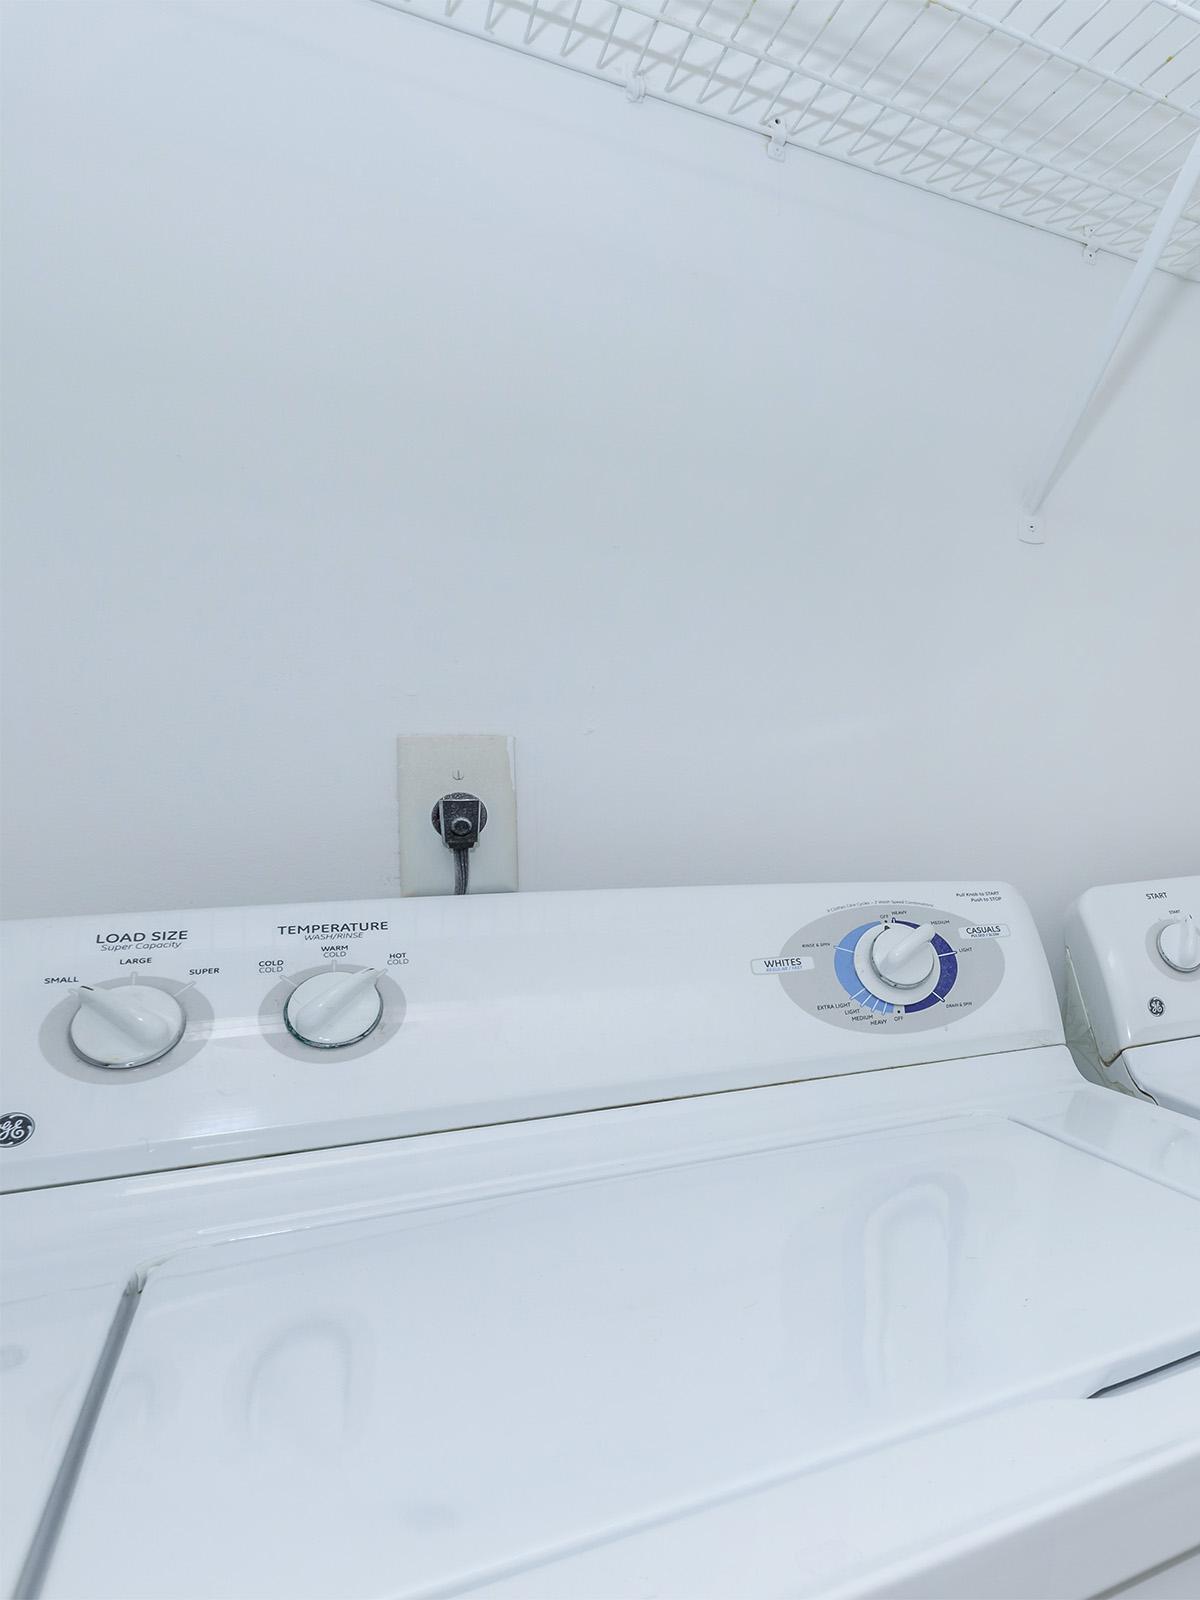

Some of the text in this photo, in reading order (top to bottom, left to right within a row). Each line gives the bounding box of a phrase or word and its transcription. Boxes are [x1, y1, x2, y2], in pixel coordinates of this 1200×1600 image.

[1146, 892, 1168, 900] START
[277, 921, 389, 935] TEMPERATURE
[966, 926, 1001, 934] CASUALS
[96, 930, 188, 944] LOAD SIZE
[304, 932, 364, 941] WASH/RINSE
[100, 941, 182, 952] Super Capacity
[119, 957, 152, 965] LARGE
[764, 958, 802, 968] WHITES
[189, 967, 220, 975] SUPER
[259, 966, 283, 974] COLD
[44, 976, 79, 984] SMALL
